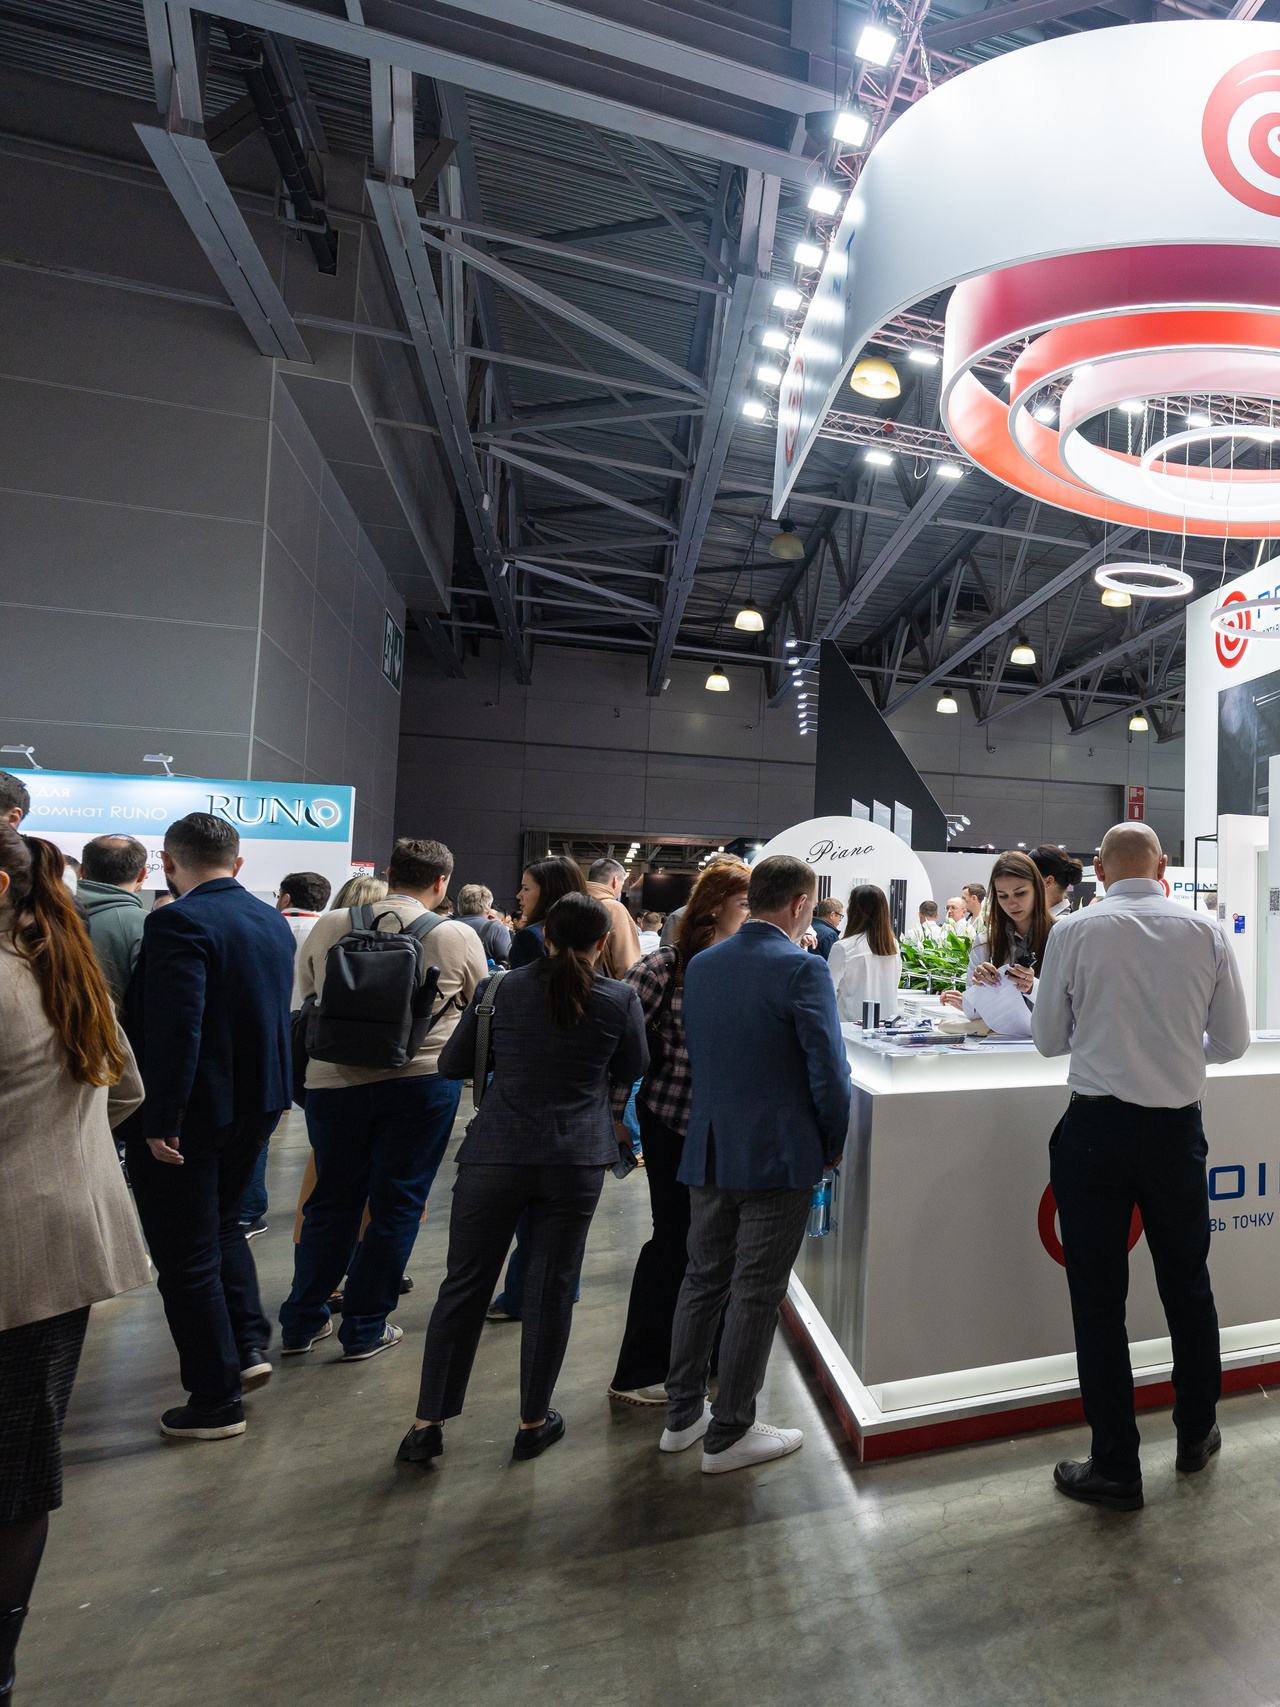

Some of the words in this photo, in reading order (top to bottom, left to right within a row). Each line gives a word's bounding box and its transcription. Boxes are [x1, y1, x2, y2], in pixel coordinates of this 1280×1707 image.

[36, 787, 70, 798] для
[110, 805, 168, 821] RUNO
[206, 794, 340, 828] RUNO
[806, 839, 875, 864] Piano
[1233, 1211, 1274, 1230] ТОЧКУ
